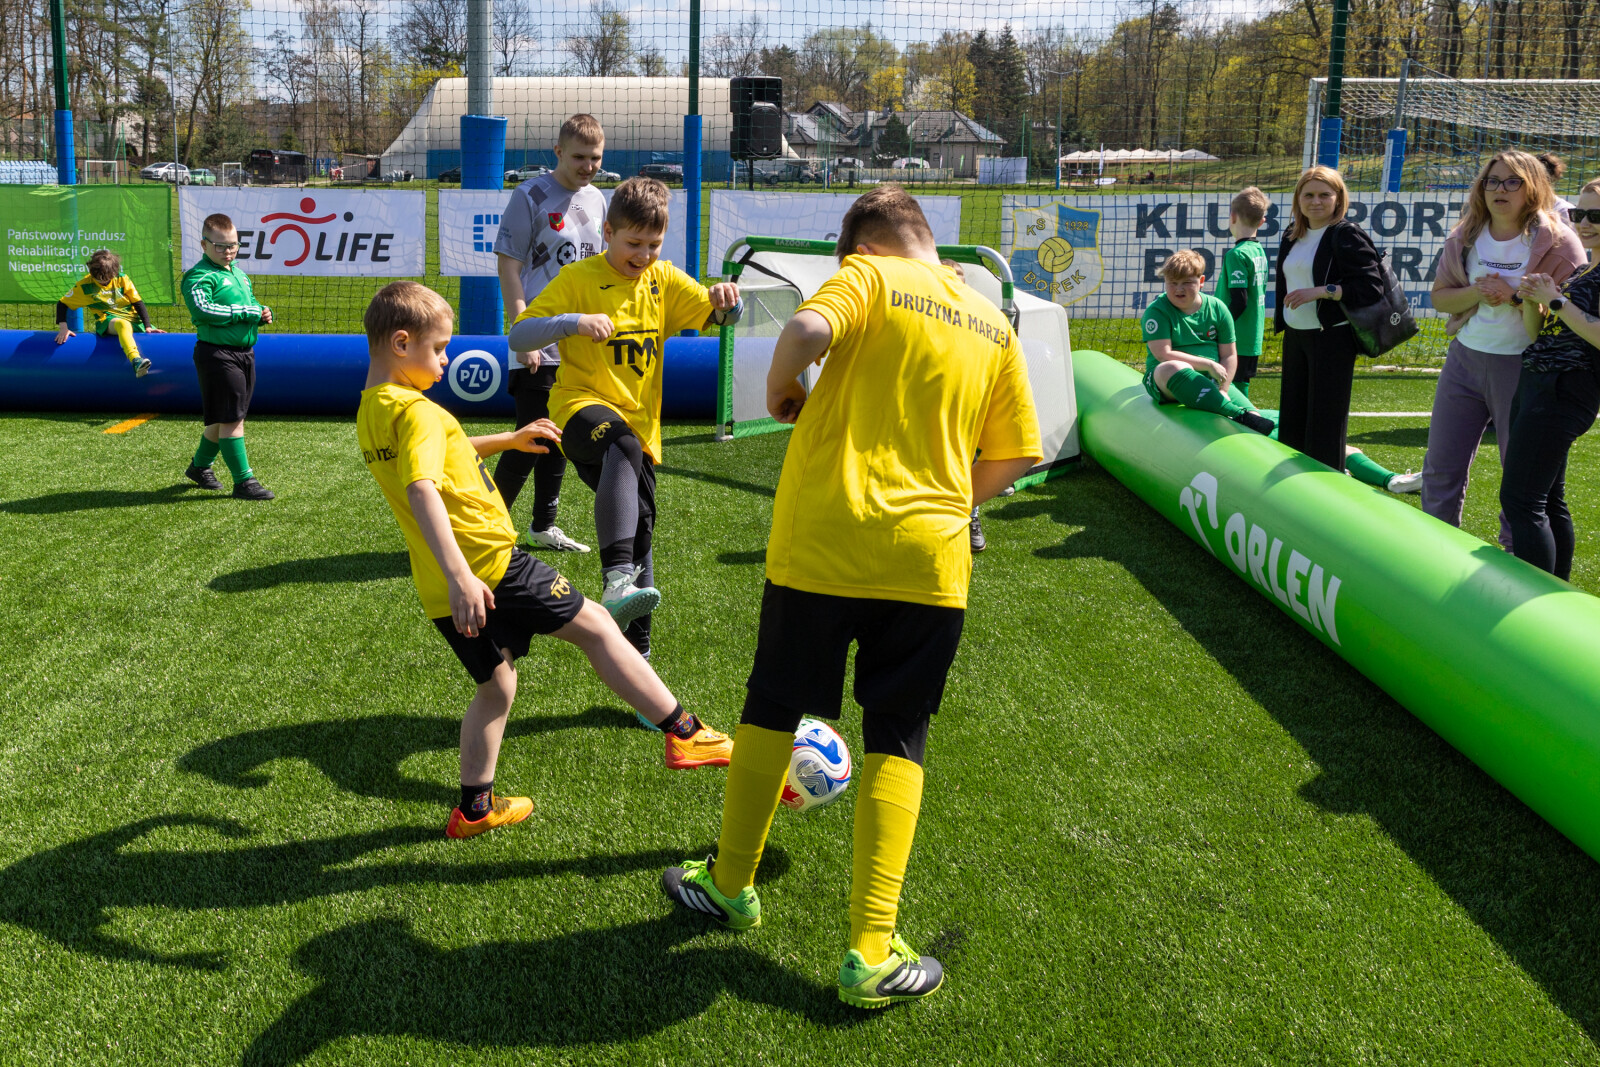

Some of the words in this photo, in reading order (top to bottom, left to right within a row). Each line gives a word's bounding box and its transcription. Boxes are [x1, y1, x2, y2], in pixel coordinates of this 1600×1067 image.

[1026, 218, 1046, 236] KS
[1065, 221, 1089, 231] 1928
[7, 228, 75, 244] Państwowy
[77, 229, 126, 241] Fundusz
[775, 238, 811, 248] BAZOOKA
[8, 244, 78, 260] Rehabilitacji
[1023, 270, 1086, 294] BOREK
[891, 289, 962, 327] DRUŻYNA
[460, 363, 490, 388] PZU
[1223, 512, 1342, 647] ORLEN
